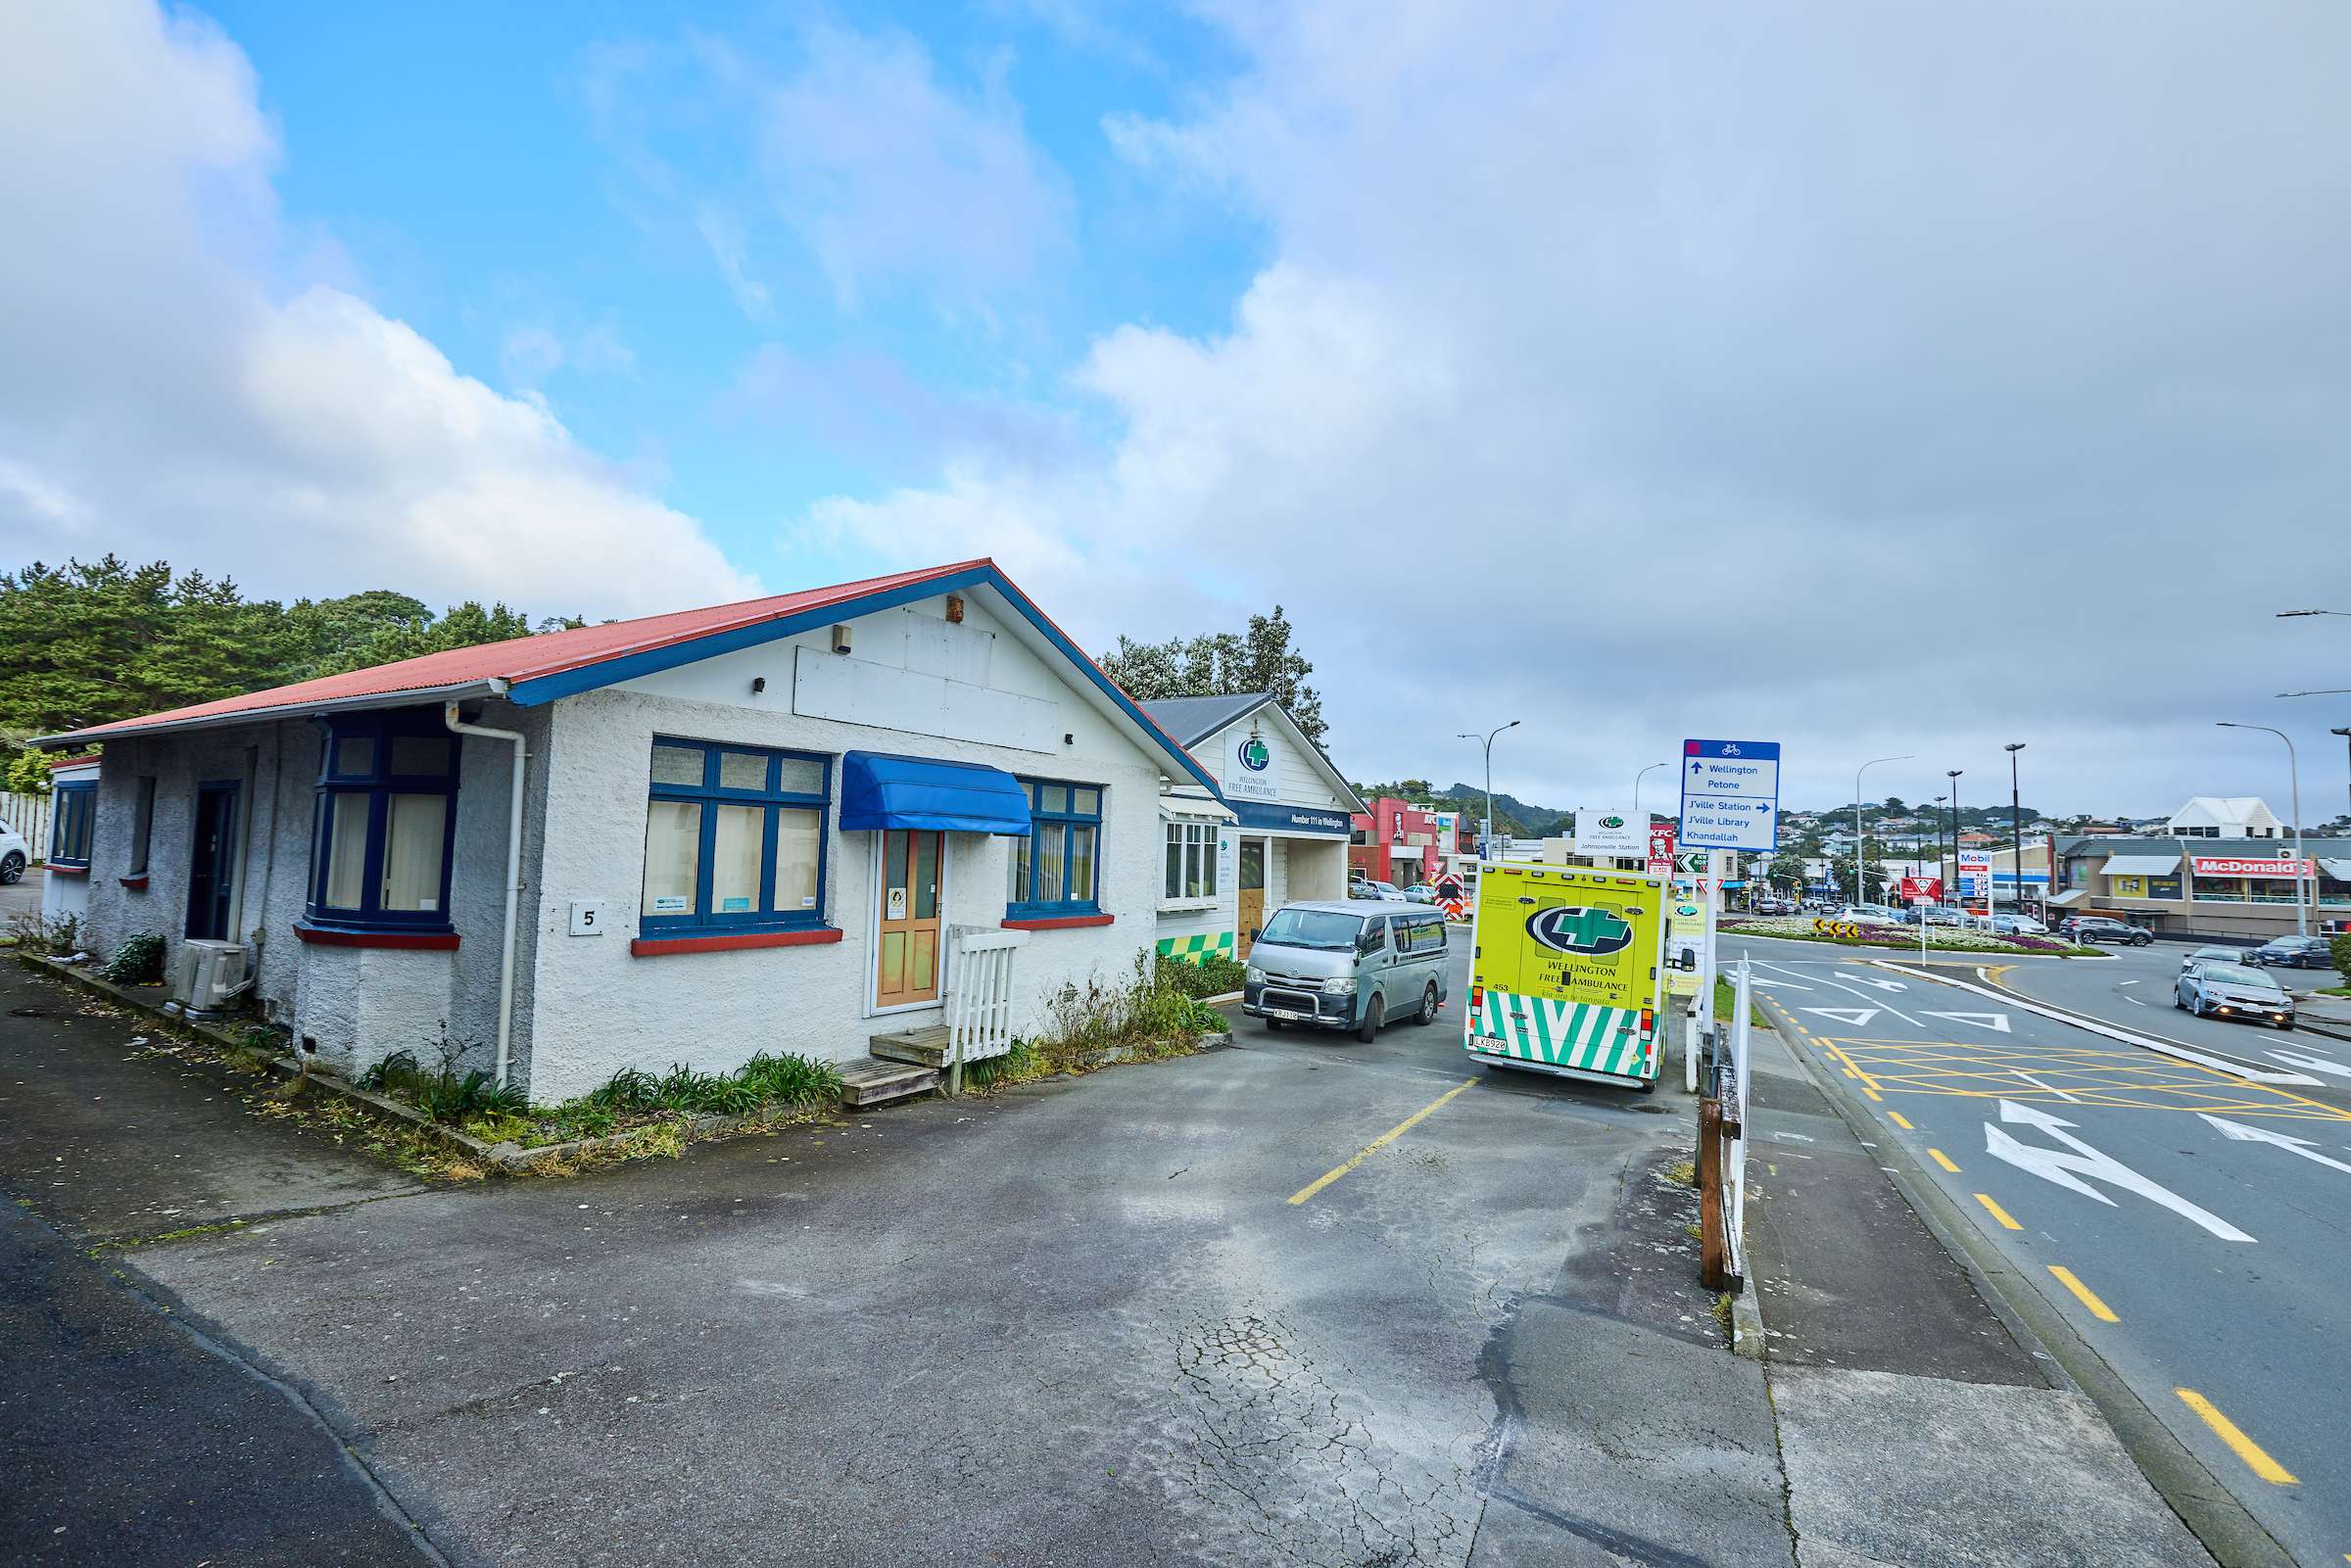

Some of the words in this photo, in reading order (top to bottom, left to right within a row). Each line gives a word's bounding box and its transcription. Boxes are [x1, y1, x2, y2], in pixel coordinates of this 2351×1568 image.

[1709, 765, 1758, 776] Wellington
[1239, 775, 1267, 785] WELLINGTON
[1707, 780, 1740, 789] Petone
[1228, 783, 1243, 792] FREE
[1243, 784, 1277, 797] AMBULANCE
[1689, 800, 1714, 810] J'ville
[1718, 801, 1751, 811] Station
[1291, 814, 1310, 826] Number
[1322, 817, 1344, 829] Wellington
[1688, 815, 1714, 825] J'ville
[1717, 817, 1750, 828] Library
[1650, 829, 1673, 837] KFC
[1687, 831, 1739, 842] Khandallah
[1961, 854, 1991, 863] Mobil
[2200, 861, 2309, 874] McDonald's
[584, 910, 595, 927] 5
[1548, 961, 1616, 977] WELLINGTON
[1493, 983, 1509, 992] 453
[1539, 974, 1562, 983] FREE
[1571, 976, 1628, 992] AMBULANCE
[1541, 989, 1553, 998] kia
[1580, 994, 1610, 1006] tangata
[1475, 1037, 1507, 1049] LKB920
